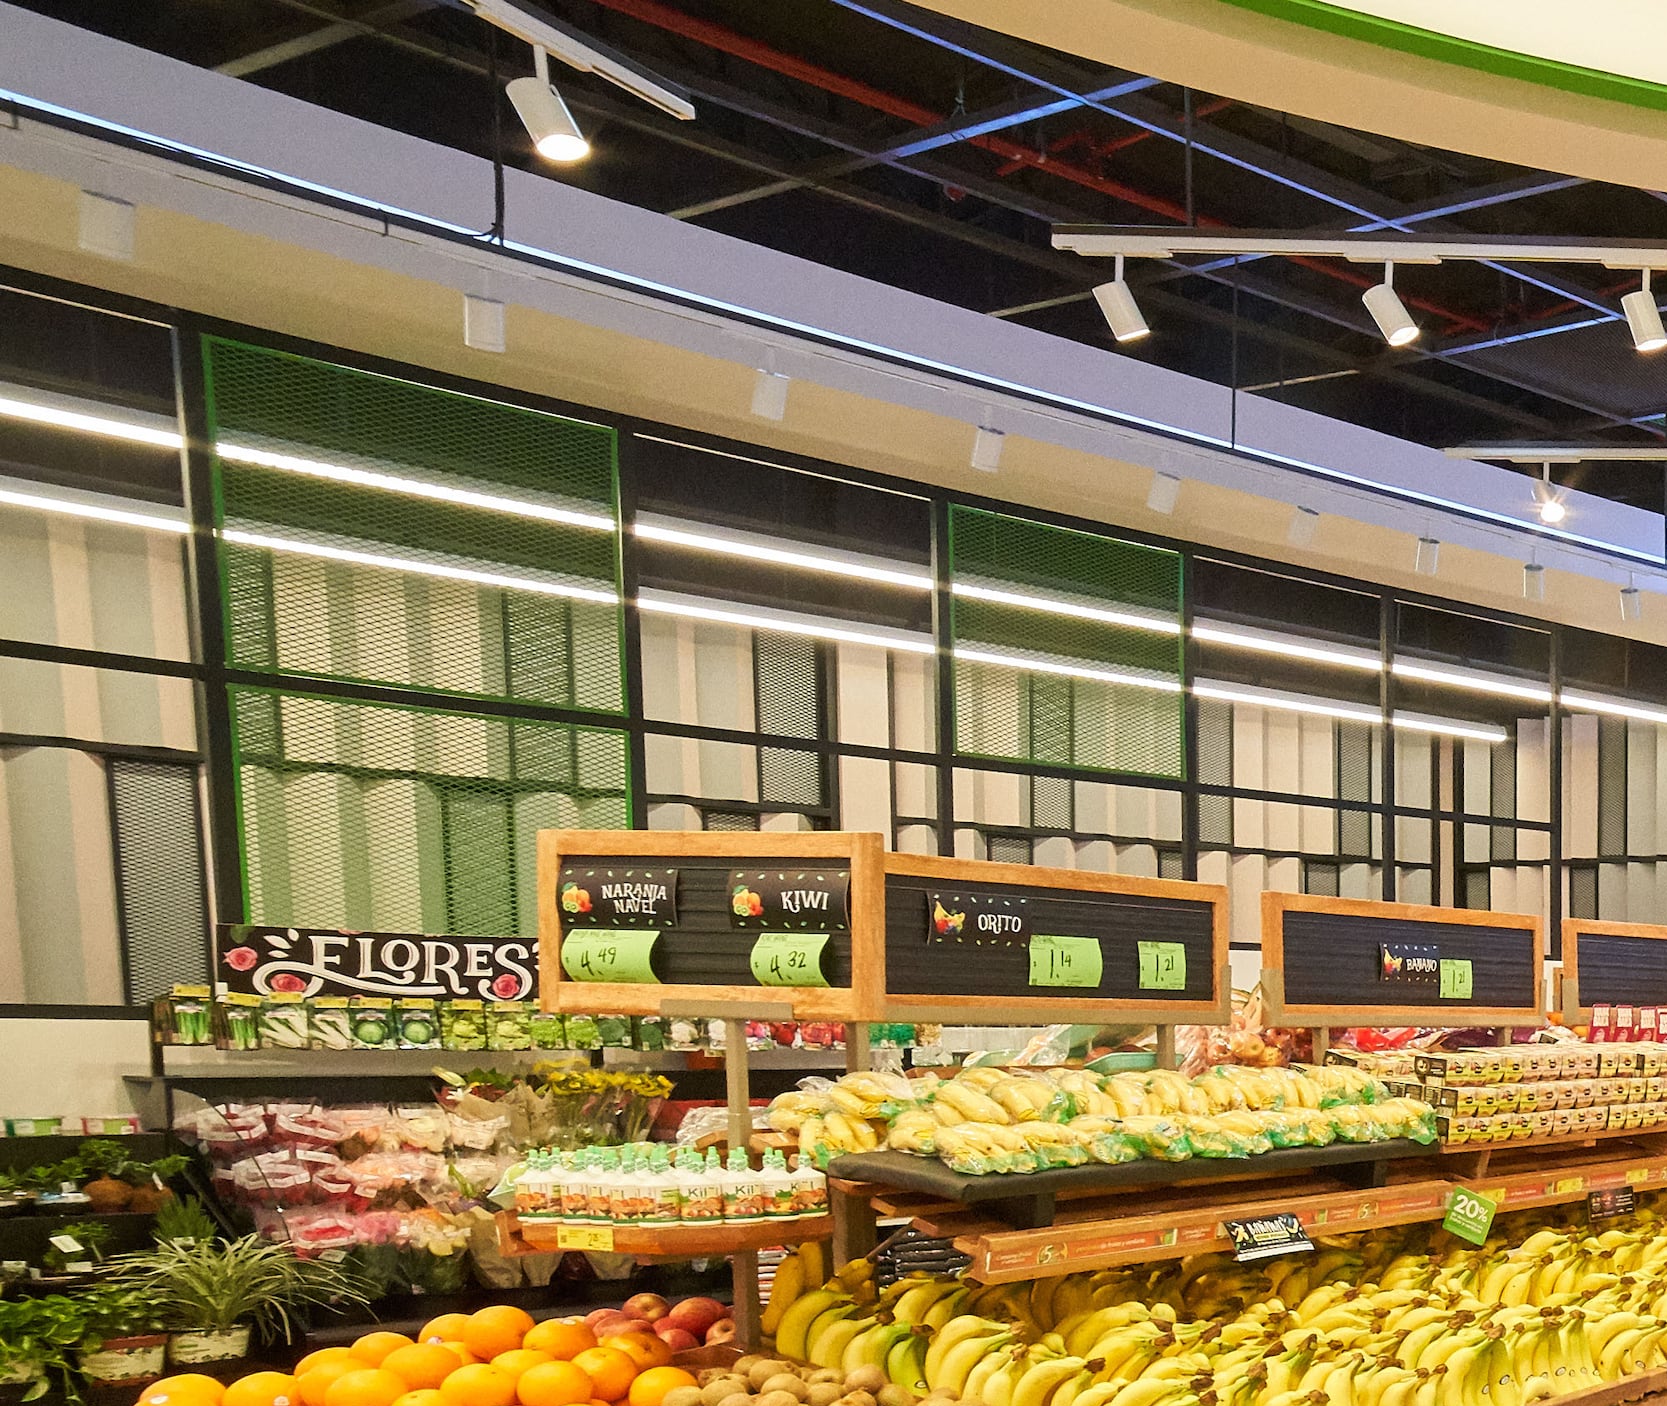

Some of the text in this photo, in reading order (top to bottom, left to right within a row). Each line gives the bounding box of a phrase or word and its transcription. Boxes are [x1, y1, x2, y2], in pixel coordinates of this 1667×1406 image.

[601, 882, 668, 903] NARANJA
[780, 890, 830, 913] KIWI
[614, 898, 657, 914] NAVEL
[977, 913, 1022, 934] ORITO
[252, 934, 533, 1001] FLORES
[1405, 958, 1437, 972] BANANO
[1454, 1194, 1489, 1223] 20%
